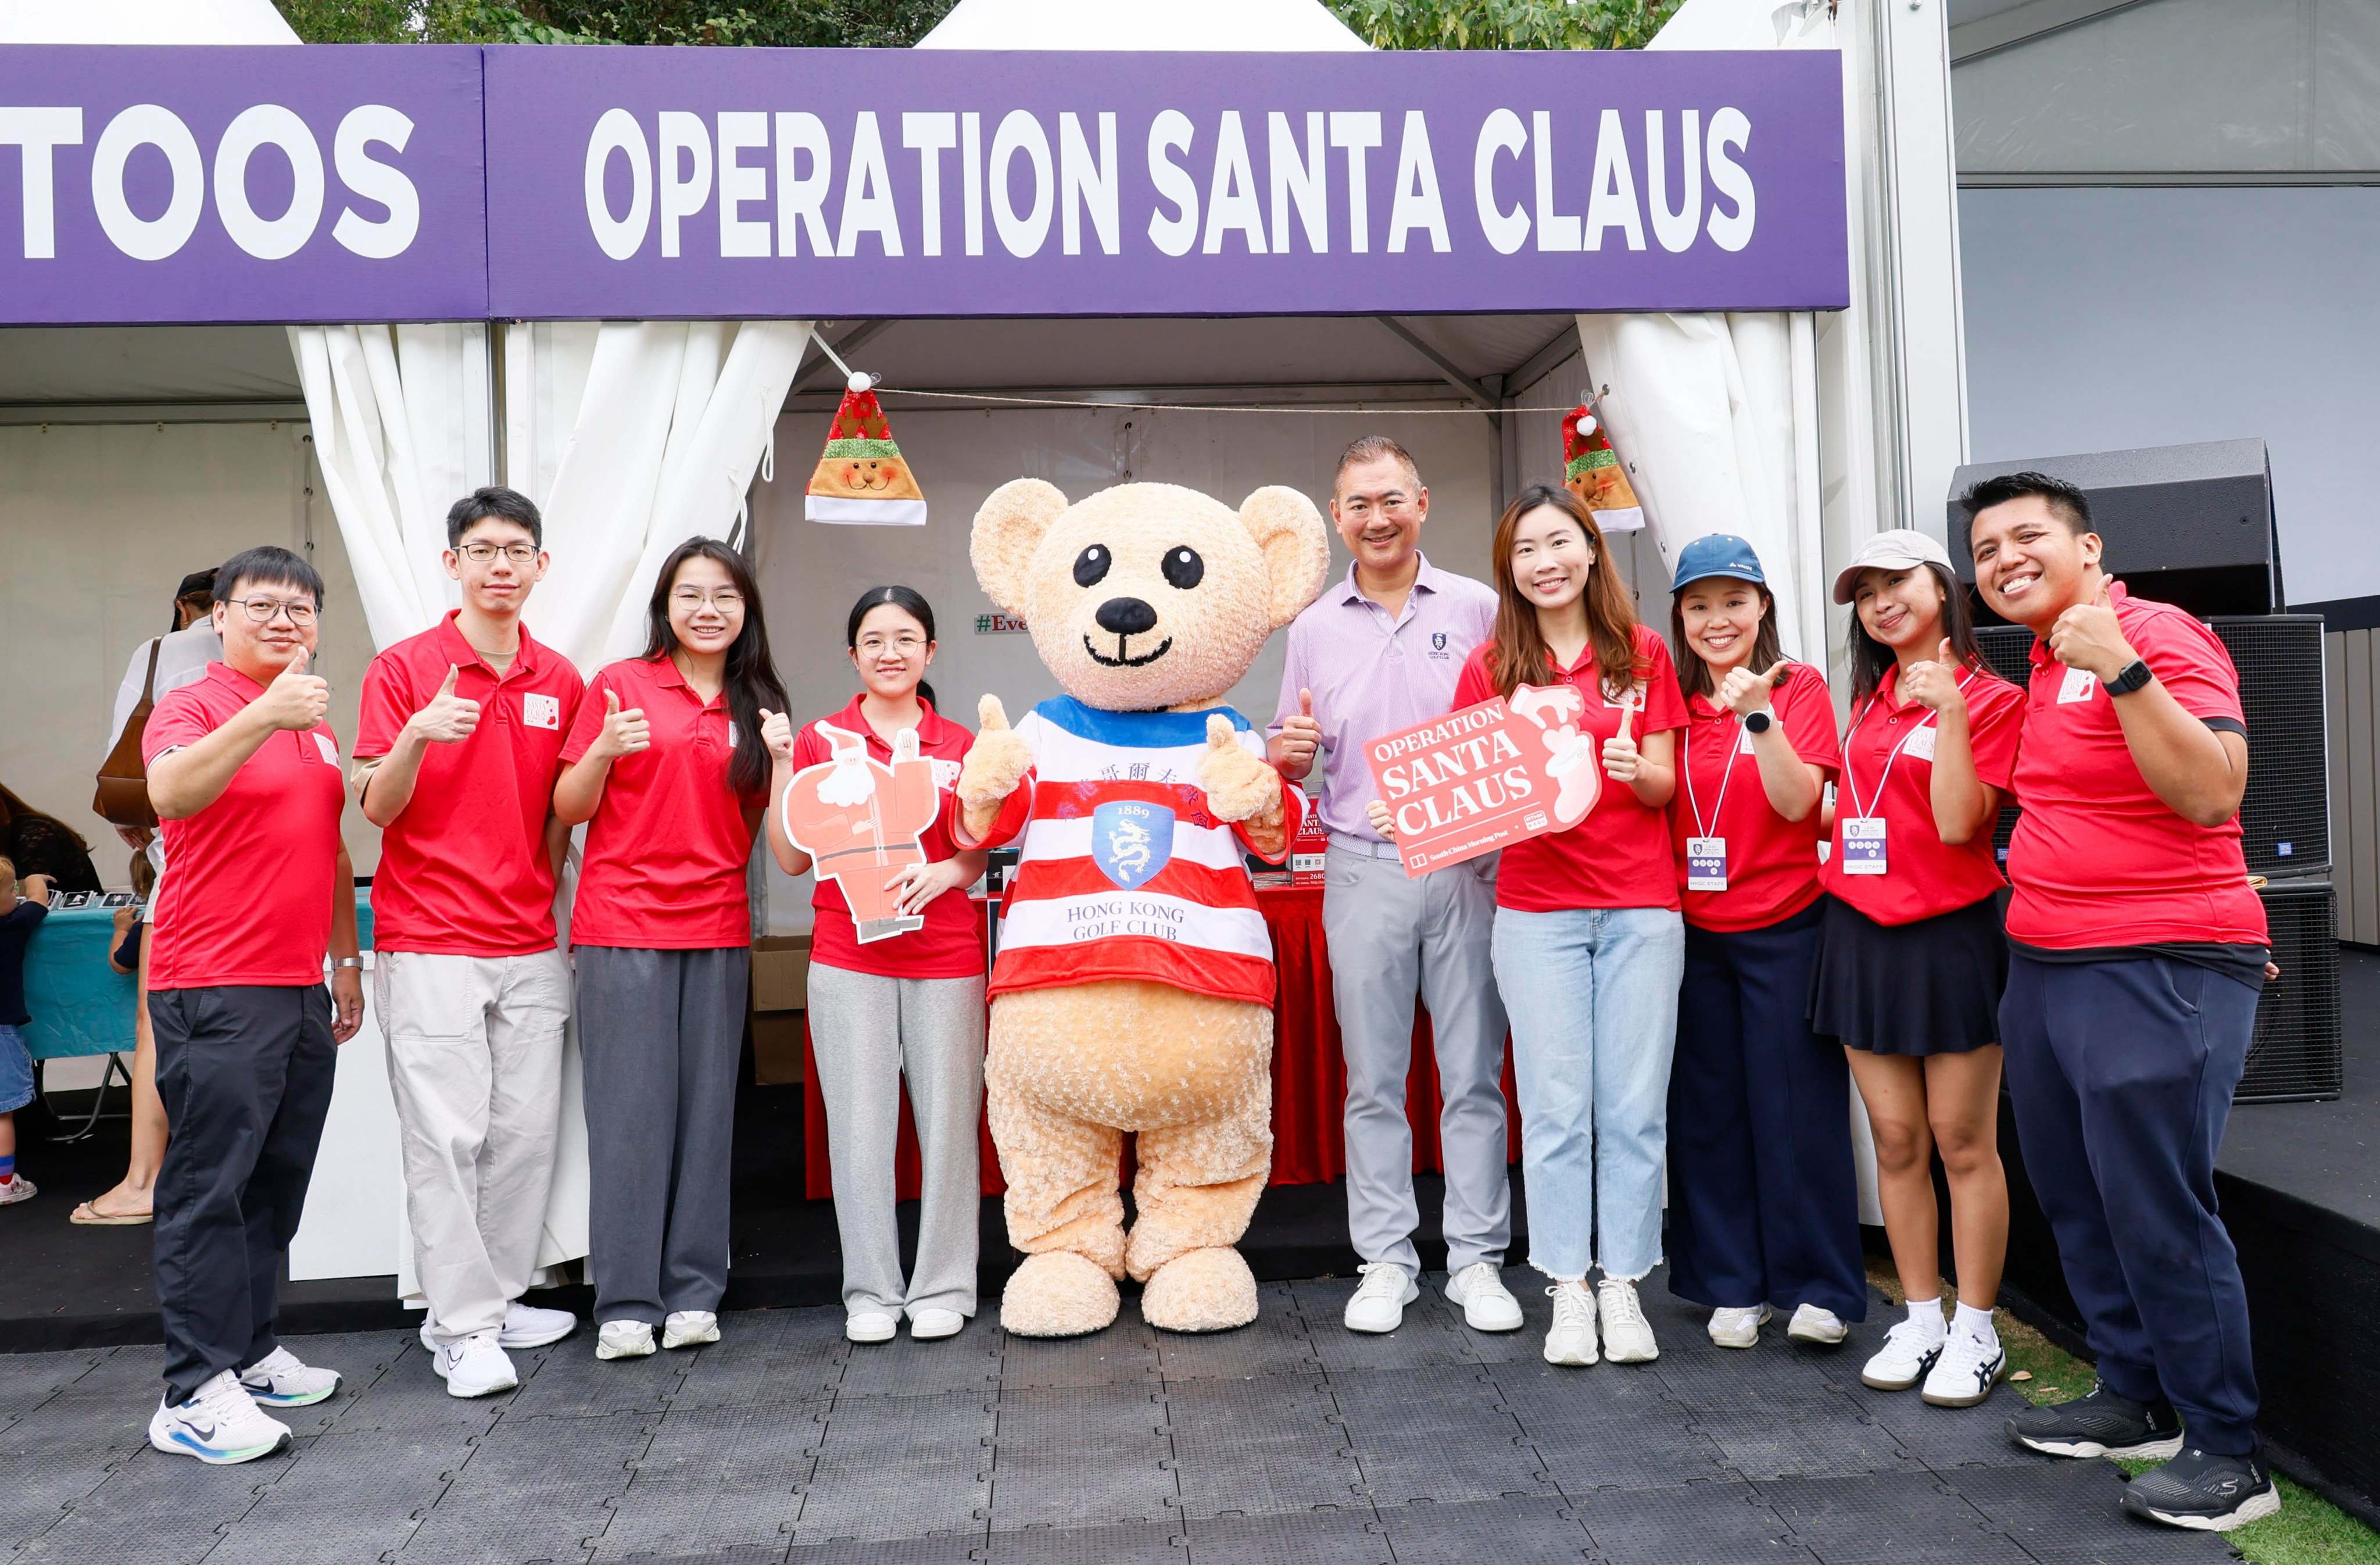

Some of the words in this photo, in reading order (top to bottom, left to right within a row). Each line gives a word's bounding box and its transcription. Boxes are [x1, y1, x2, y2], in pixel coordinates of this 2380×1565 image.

[584, 107, 1121, 260] OPERATION
[1147, 109, 1452, 257] SANTA
[1473, 106, 1756, 255] CLAUS
[1375, 703, 1505, 762] OPERATION
[1382, 729, 1522, 800] SANTA
[1117, 805, 1150, 819] 1889
[1396, 764, 1533, 835] CLAUS
[1430, 851, 1448, 861] South
[1448, 844, 1468, 855] China
[1467, 835, 1495, 849] Morning
[1494, 830, 1509, 839] Post
[1067, 901, 1122, 923] HONG
[1129, 902, 1184, 923] KONG
[1073, 920, 1121, 940] GOLF
[1126, 920, 1177, 941] CLUB
